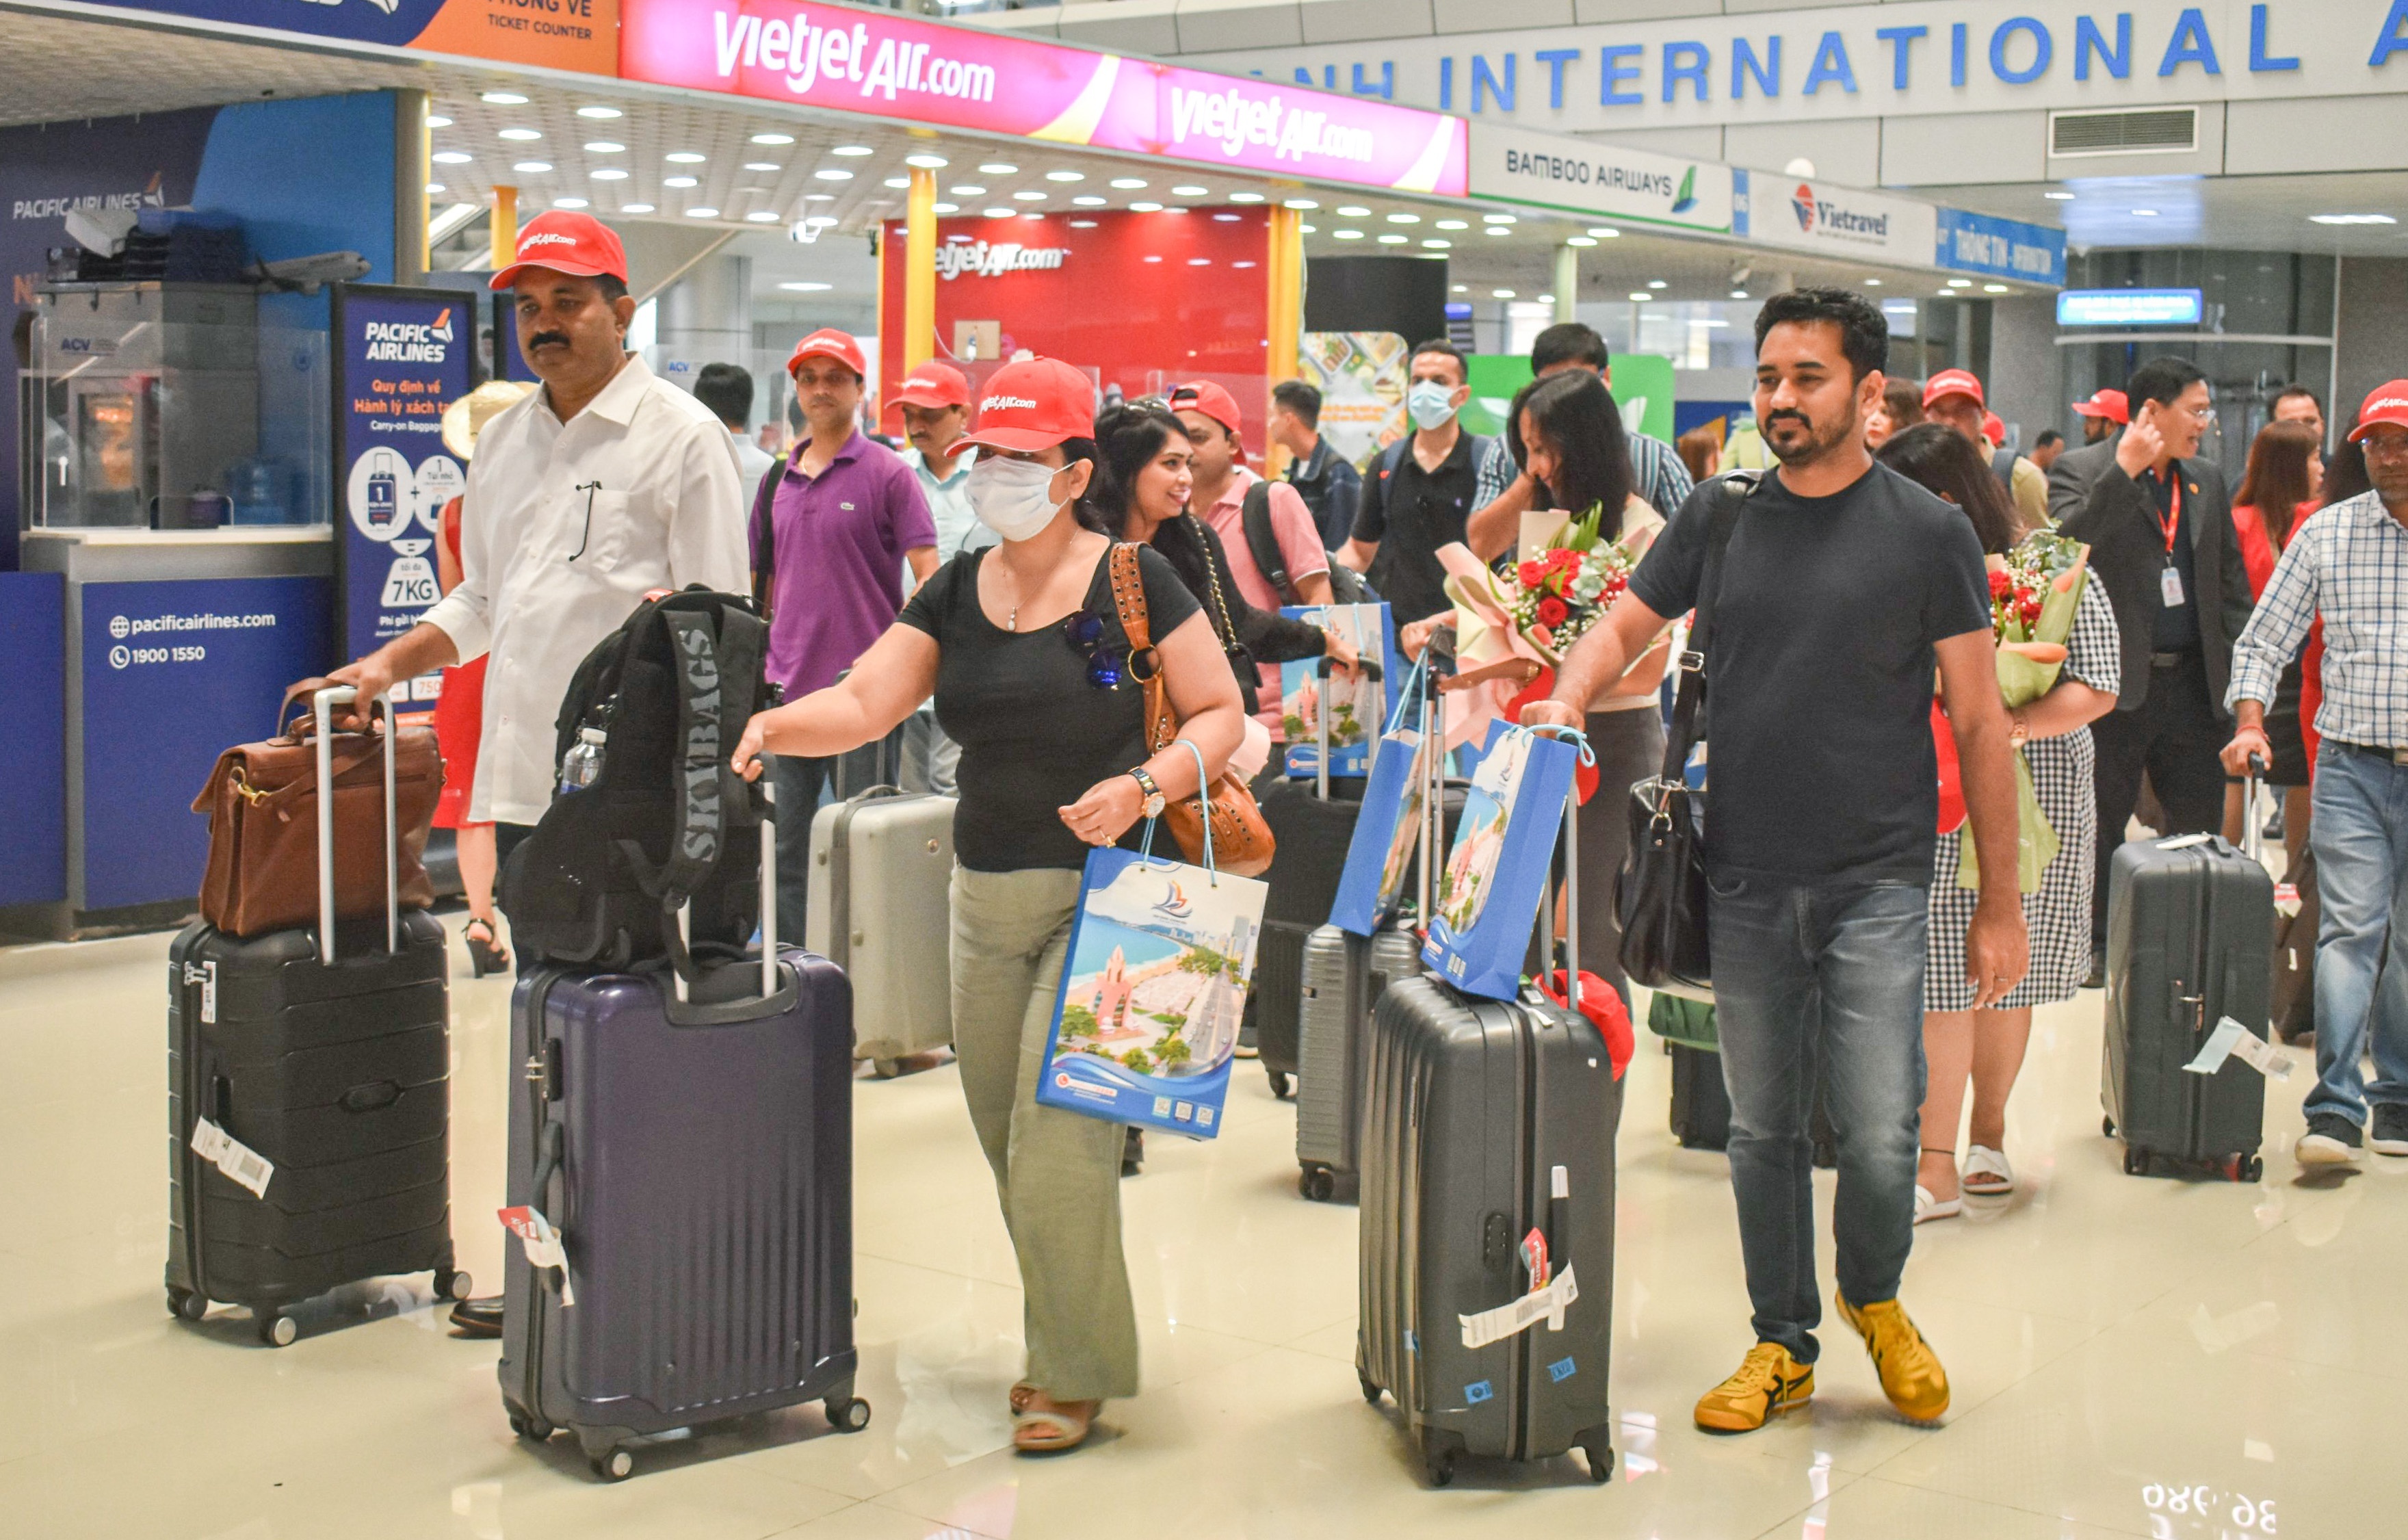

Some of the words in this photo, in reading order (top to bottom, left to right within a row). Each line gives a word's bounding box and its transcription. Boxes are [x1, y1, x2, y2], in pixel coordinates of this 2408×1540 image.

[488, 14, 529, 30] TICKET
[534, 21, 592, 40] COUNTER
[1440, 3, 2301, 114] INTERNATIONAL
[1507, 150, 1590, 184] BAMBOO
[1595, 166, 1673, 196] AIRWAYS
[12, 197, 69, 220] PACIFIC
[1816, 200, 1888, 236] Vietravel
[935, 240, 1063, 280] etjetAir.com
[365, 322, 431, 343] PACIFIC
[61, 337, 90, 350] ACV
[366, 342, 445, 363] AIRLINES
[668, 361, 690, 373] ACV
[371, 379, 396, 395] Quy
[399, 380, 424, 395] định
[354, 398, 388, 413] Hành
[391, 398, 403, 416] lý
[405, 399, 435, 413] xách
[980, 395, 1036, 415] jetAir.com
[370, 420, 407, 432] Carry-on
[408, 421, 443, 433] Baggag
[377, 486, 383, 501] 1
[393, 579, 432, 601] 7KG
[131, 613, 276, 636] pacificairlines.com
[133, 648, 169, 664] 1900
[172, 646, 205, 662] 1550
[679, 628, 720, 863] SKYBAGS
